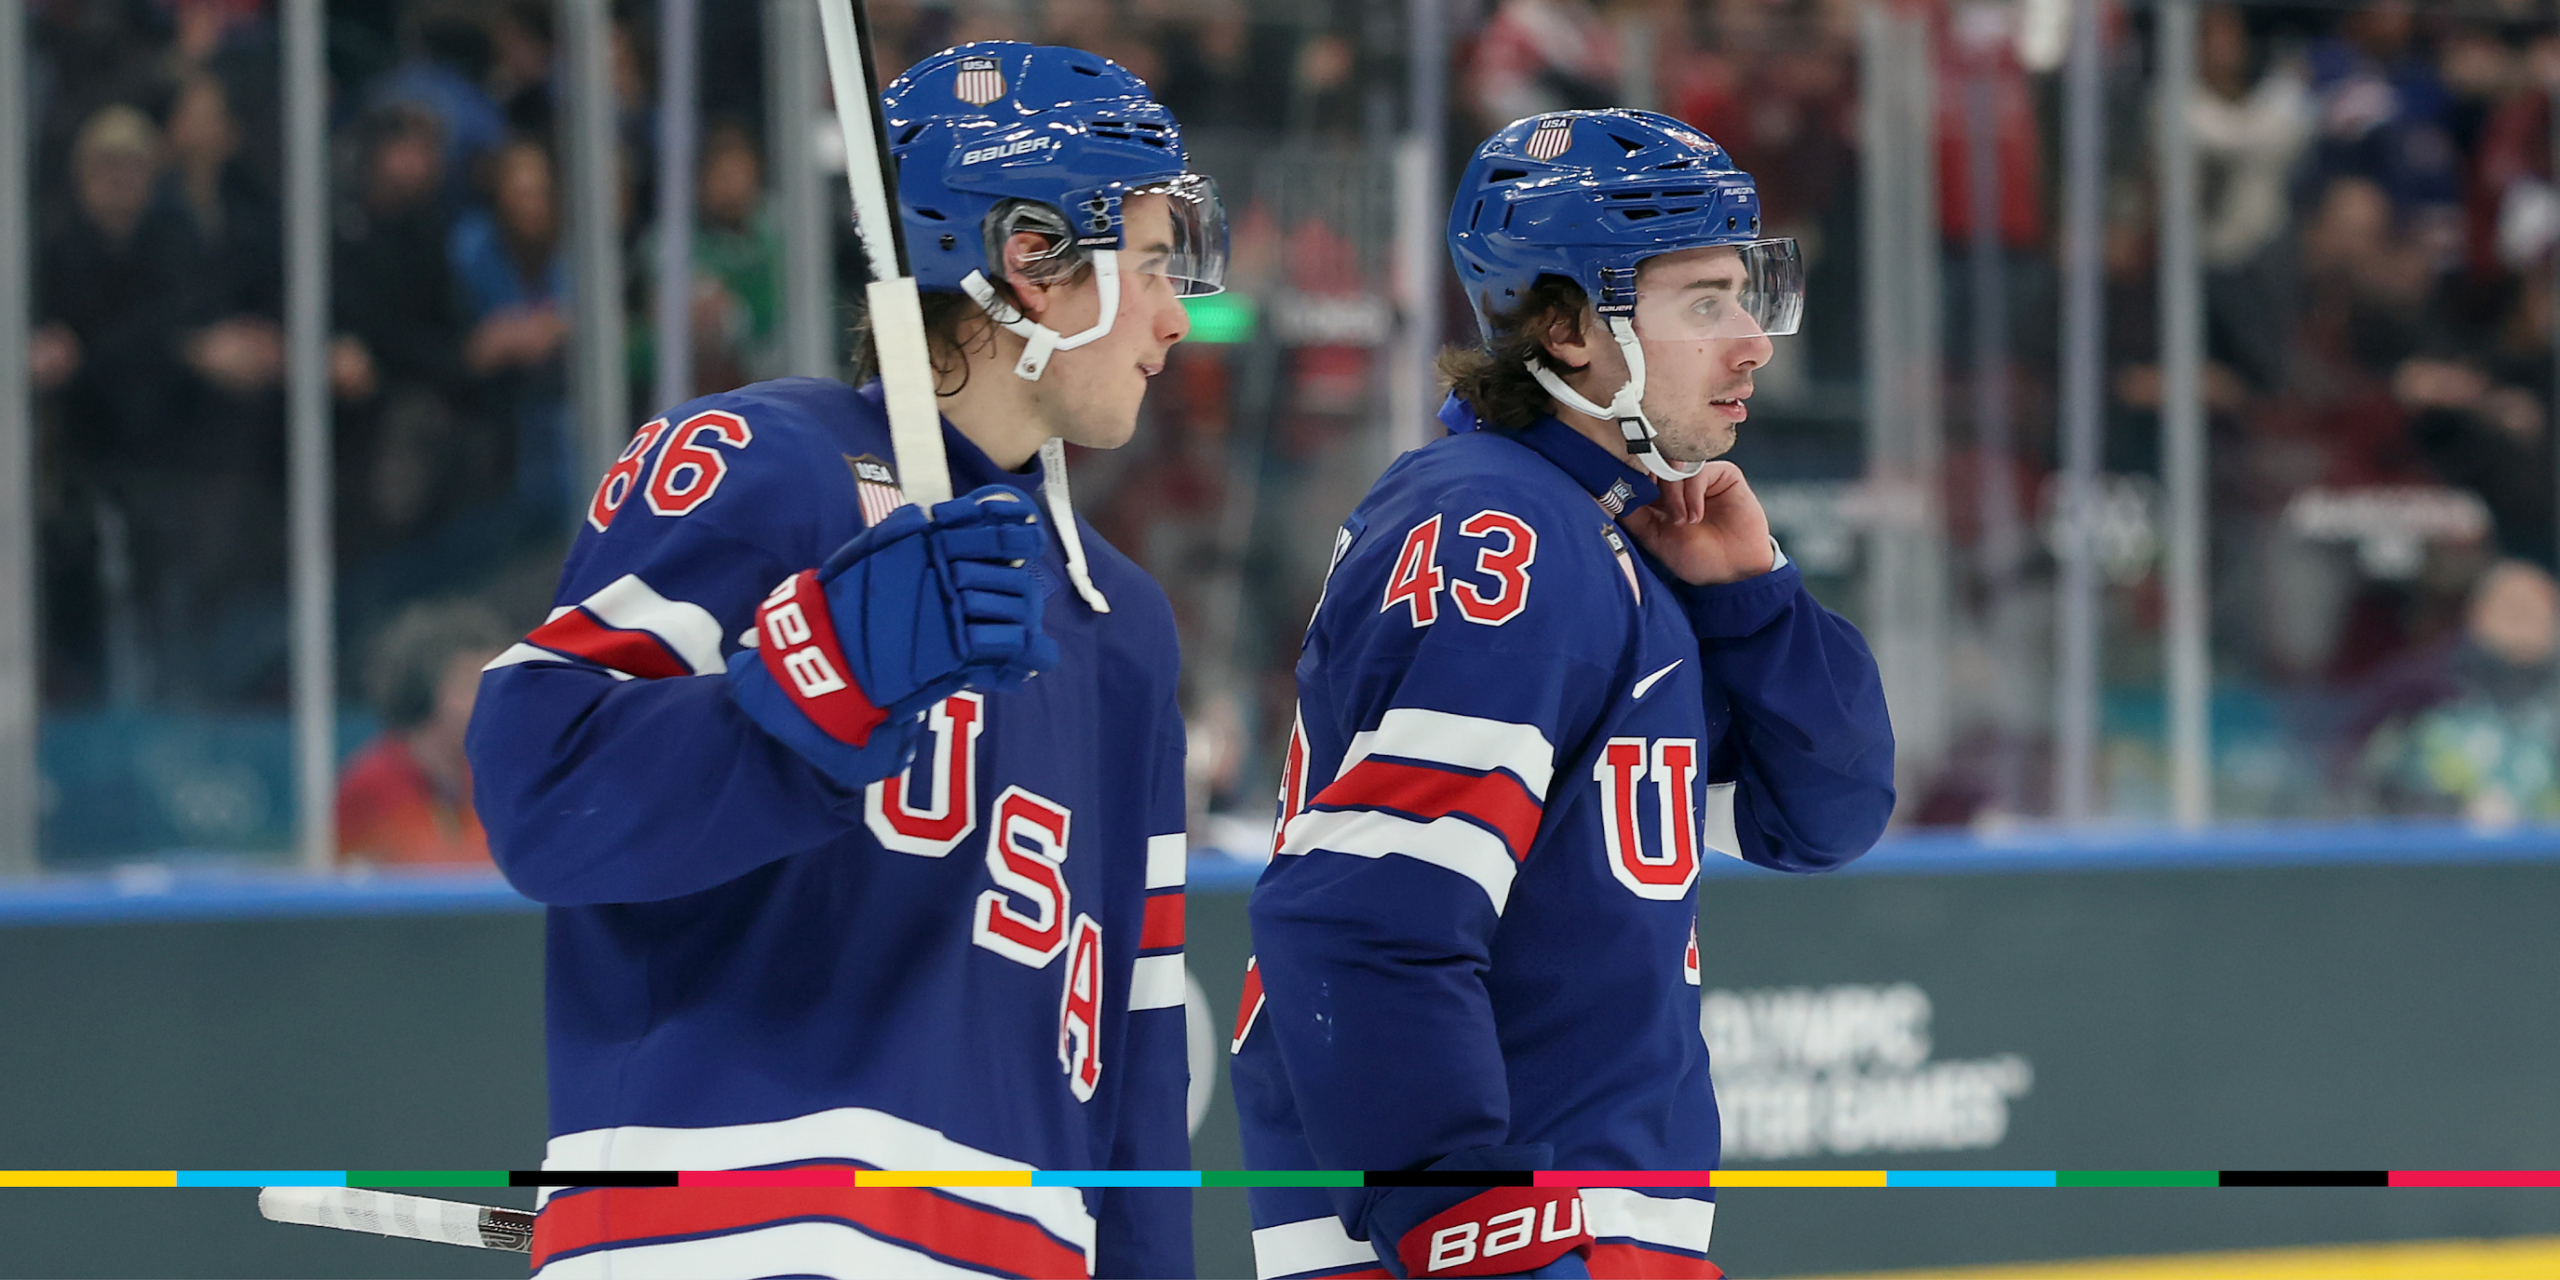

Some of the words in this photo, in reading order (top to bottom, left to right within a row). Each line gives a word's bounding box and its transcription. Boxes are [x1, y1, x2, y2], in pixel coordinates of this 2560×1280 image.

[962, 60, 995, 71] USA
[1541, 118, 1567, 129] USA
[588, 409, 752, 533] 86
[854, 462, 894, 484] USA
[1613, 482, 1630, 501] USA
[1380, 509, 1539, 629] 43
